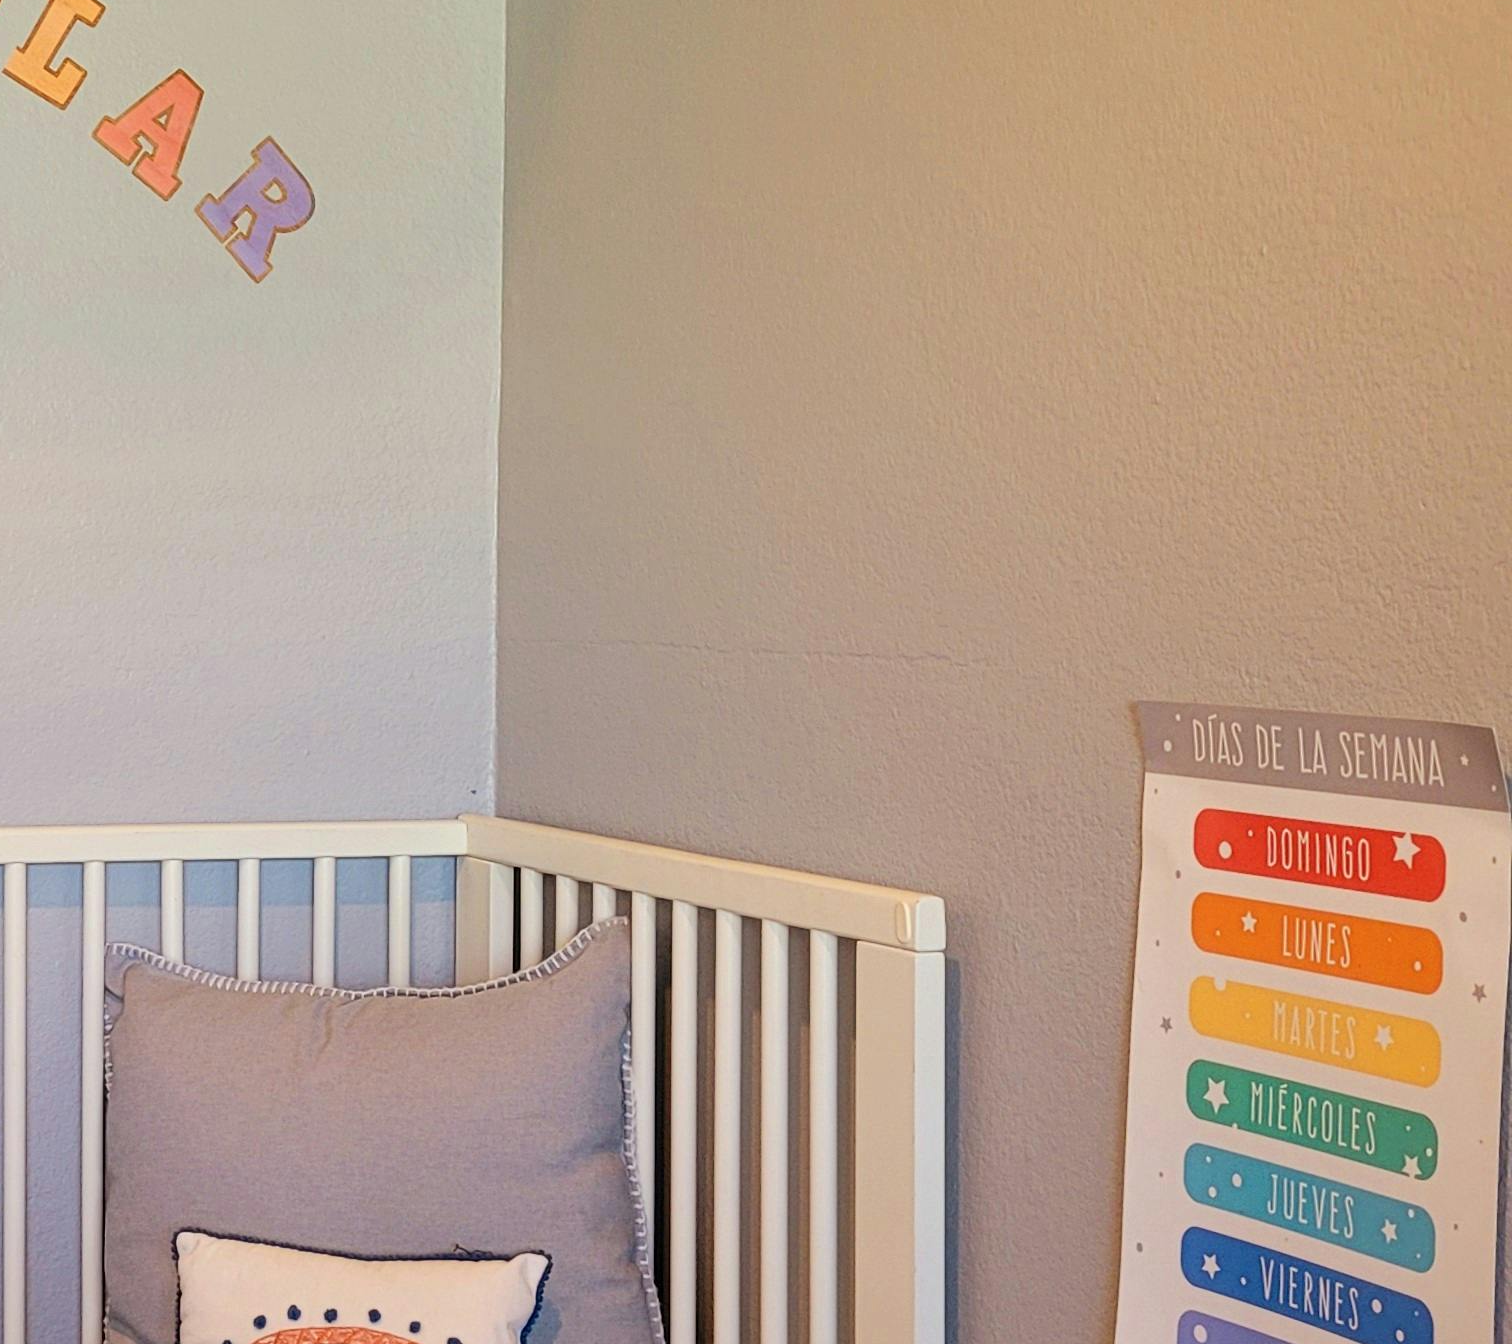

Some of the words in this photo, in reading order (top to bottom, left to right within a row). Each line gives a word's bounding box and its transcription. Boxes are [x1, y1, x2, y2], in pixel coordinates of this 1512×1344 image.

[1192, 714, 1244, 768] DÍAS
[1255, 724, 1285, 772] DE
[1297, 727, 1328, 776] LA
[1339, 731, 1445, 787] SEMANA
[1267, 825, 1371, 882] DOMINGO
[1282, 915, 1352, 969] LUNES
[1272, 1000, 1357, 1060] MARTES
[1250, 1081, 1377, 1155] MIÉRCOLES
[1266, 1174, 1356, 1240] JUEVES
[1260, 1256, 1359, 1331] VIERNES
